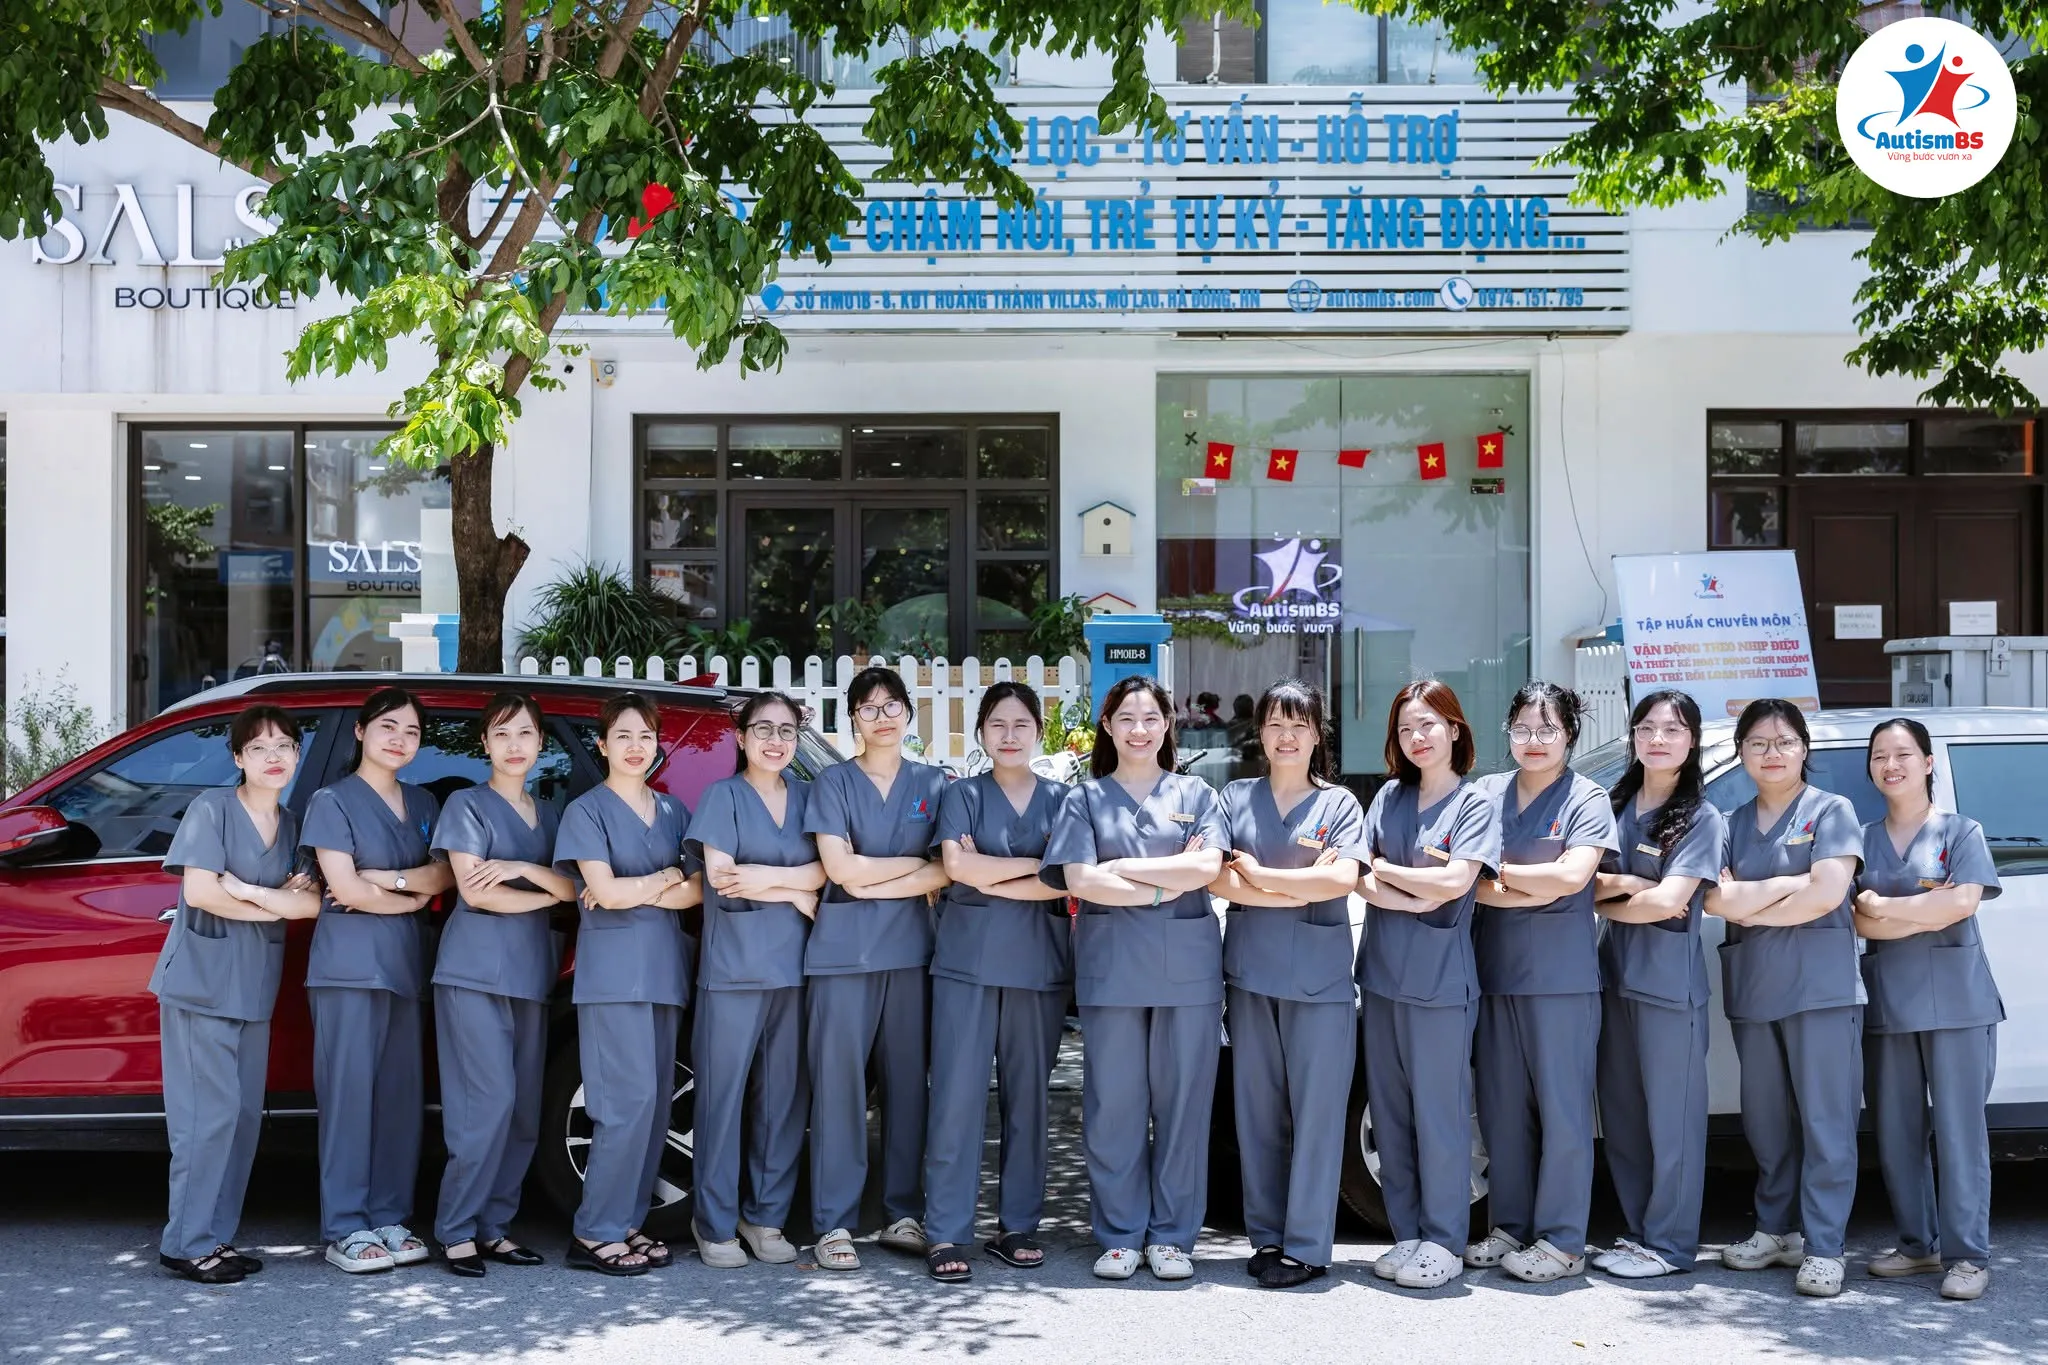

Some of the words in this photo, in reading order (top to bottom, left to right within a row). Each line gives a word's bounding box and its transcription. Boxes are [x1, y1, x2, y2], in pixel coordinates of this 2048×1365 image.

[1028, 114, 1101, 181] LỌC
[1200, 93, 1279, 165] VẤN
[1317, 92, 1369, 165] HỖ
[1383, 109, 1460, 179] TRỢ
[866, 187, 982, 265] CHẬM
[997, 187, 1075, 257] NÓI,
[1085, 179, 1156, 250] TRẺ
[1170, 194, 1225, 264] TỰ
[1235, 179, 1286, 250] KỶ
[1321, 185, 1425, 250] TĂNG
[115, 287, 296, 311] BOUTIQUE
[793, 284, 815, 311] SỐ
[935, 284, 988, 310] HOÀNG
[1168, 284, 1188, 309] HÀ
[1239, 288, 1261, 309] HN
[1326, 289, 1435, 307] autismbs.com
[1249, 600, 1340, 618] AutismBS
[1637, 617, 1662, 633] TẬP
[1666, 613, 1703, 630] HUẤN
[1707, 613, 1758, 628] CHUYÊN
[1761, 612, 1791, 627] MÔN
[1633, 643, 1661, 658] VẬN
[1634, 673, 1658, 683] CHO
